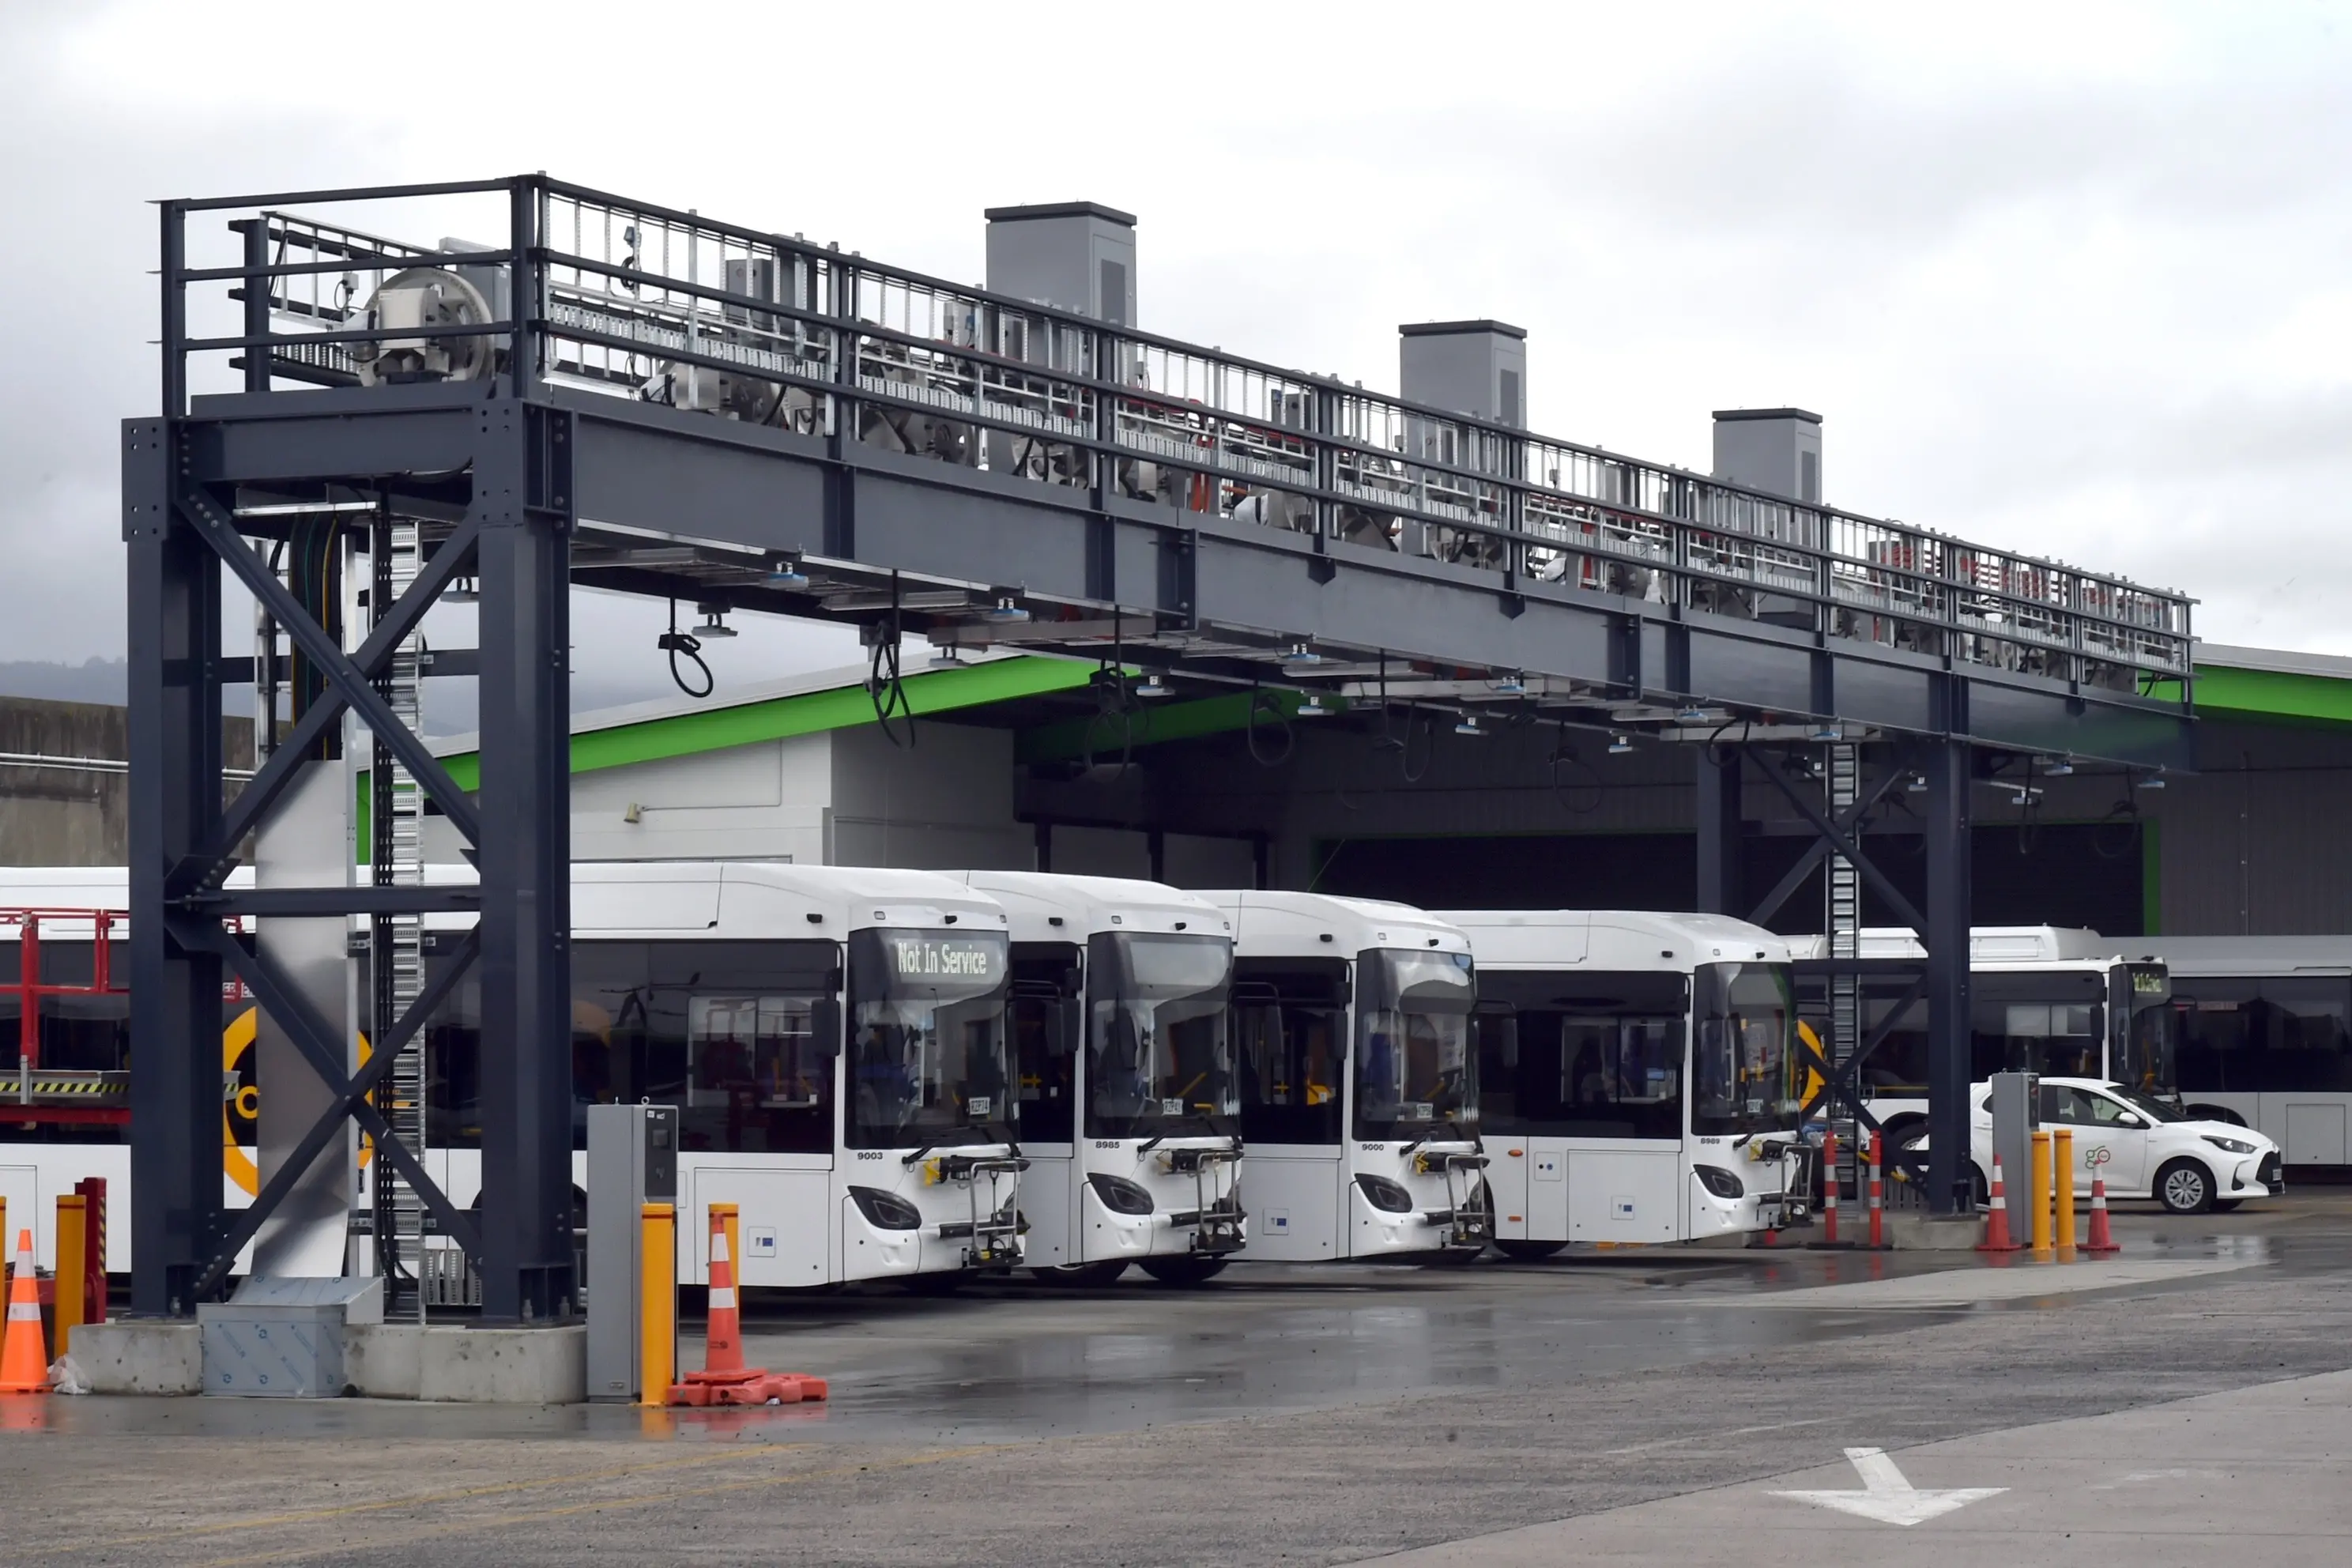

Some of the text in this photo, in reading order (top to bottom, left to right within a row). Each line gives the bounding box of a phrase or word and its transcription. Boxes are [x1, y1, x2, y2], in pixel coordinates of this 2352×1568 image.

[898, 942, 986, 974] Not In Service
[1095, 1140, 1120, 1149] 8985
[857, 1152, 884, 1160] 9003
